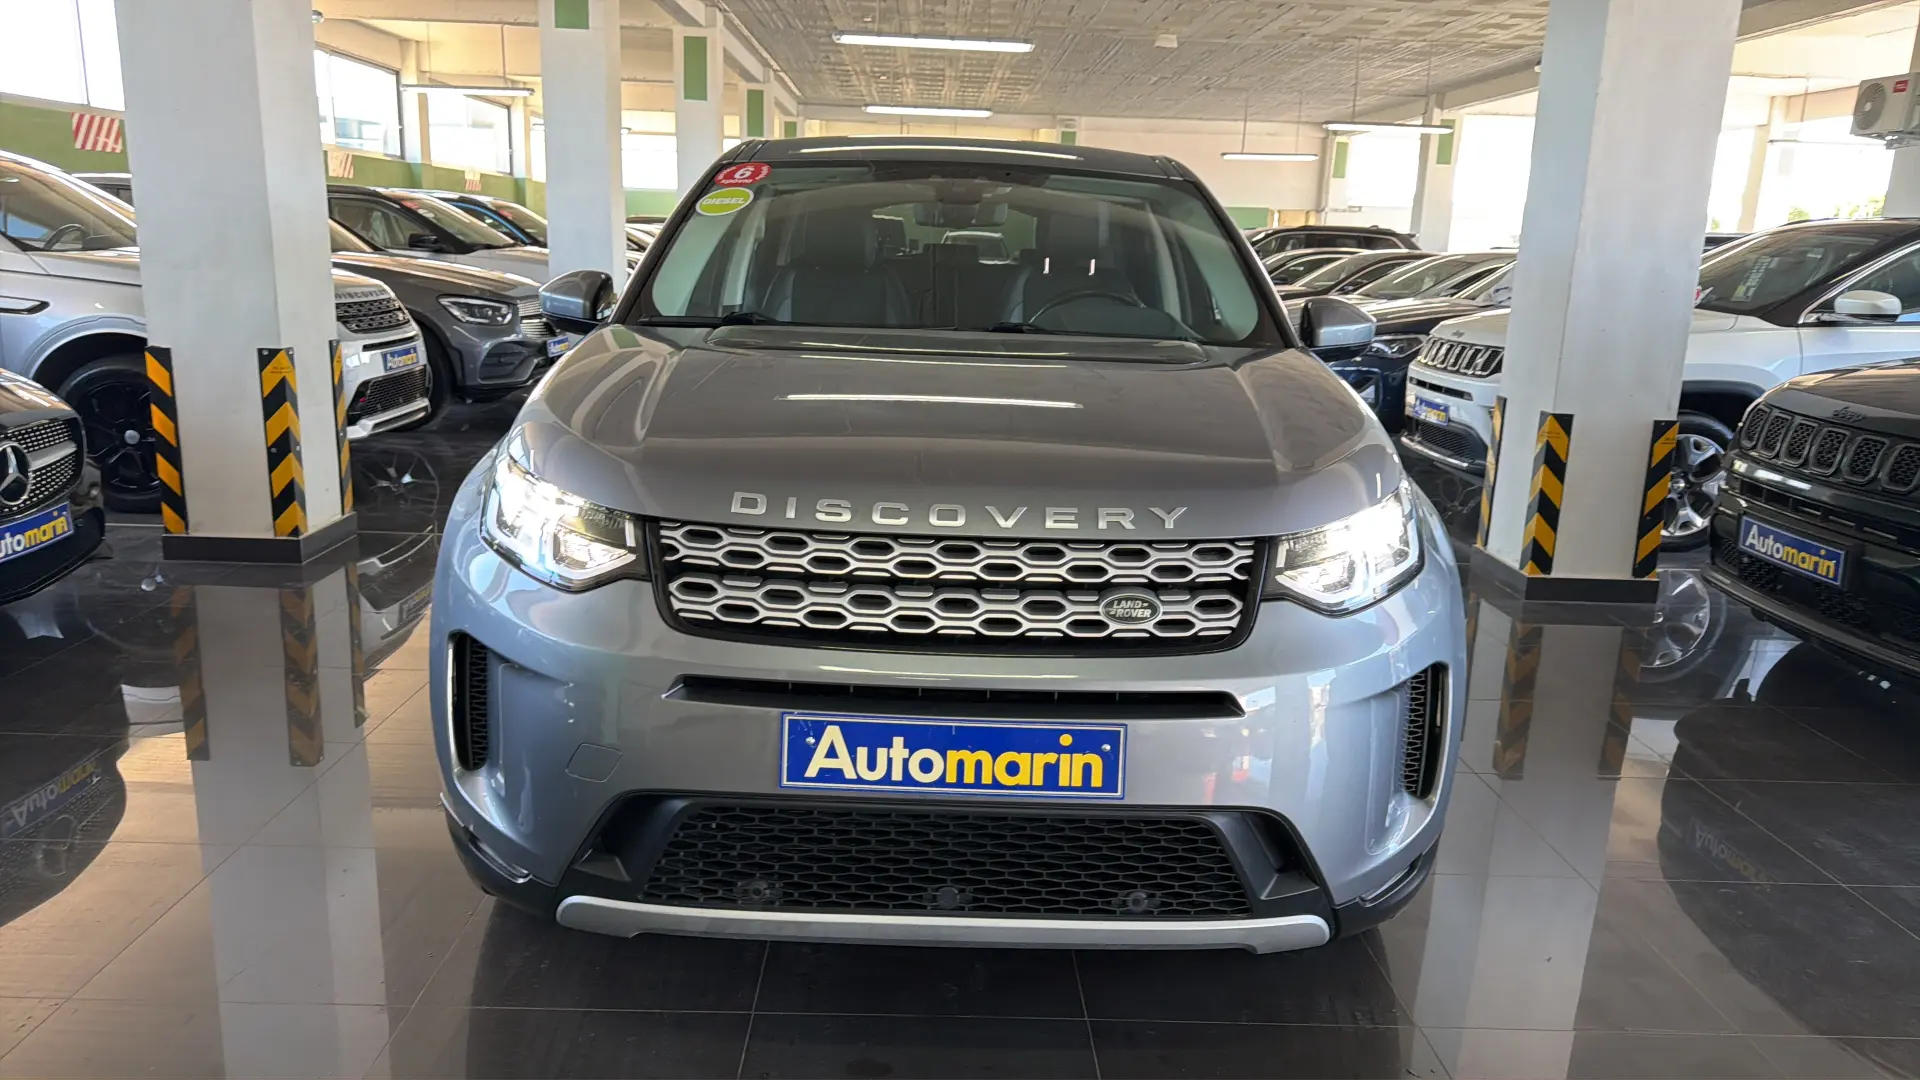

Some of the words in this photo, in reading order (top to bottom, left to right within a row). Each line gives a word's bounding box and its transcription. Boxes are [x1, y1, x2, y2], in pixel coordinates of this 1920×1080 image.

[734, 167, 755, 179] 6
[730, 491, 1187, 530] DISCOVERY
[1745, 524, 1836, 578] Automarin
[1113, 600, 1142, 609] LAND
[1116, 608, 1152, 618] ROVER
[804, 725, 1103, 787] Automarin
